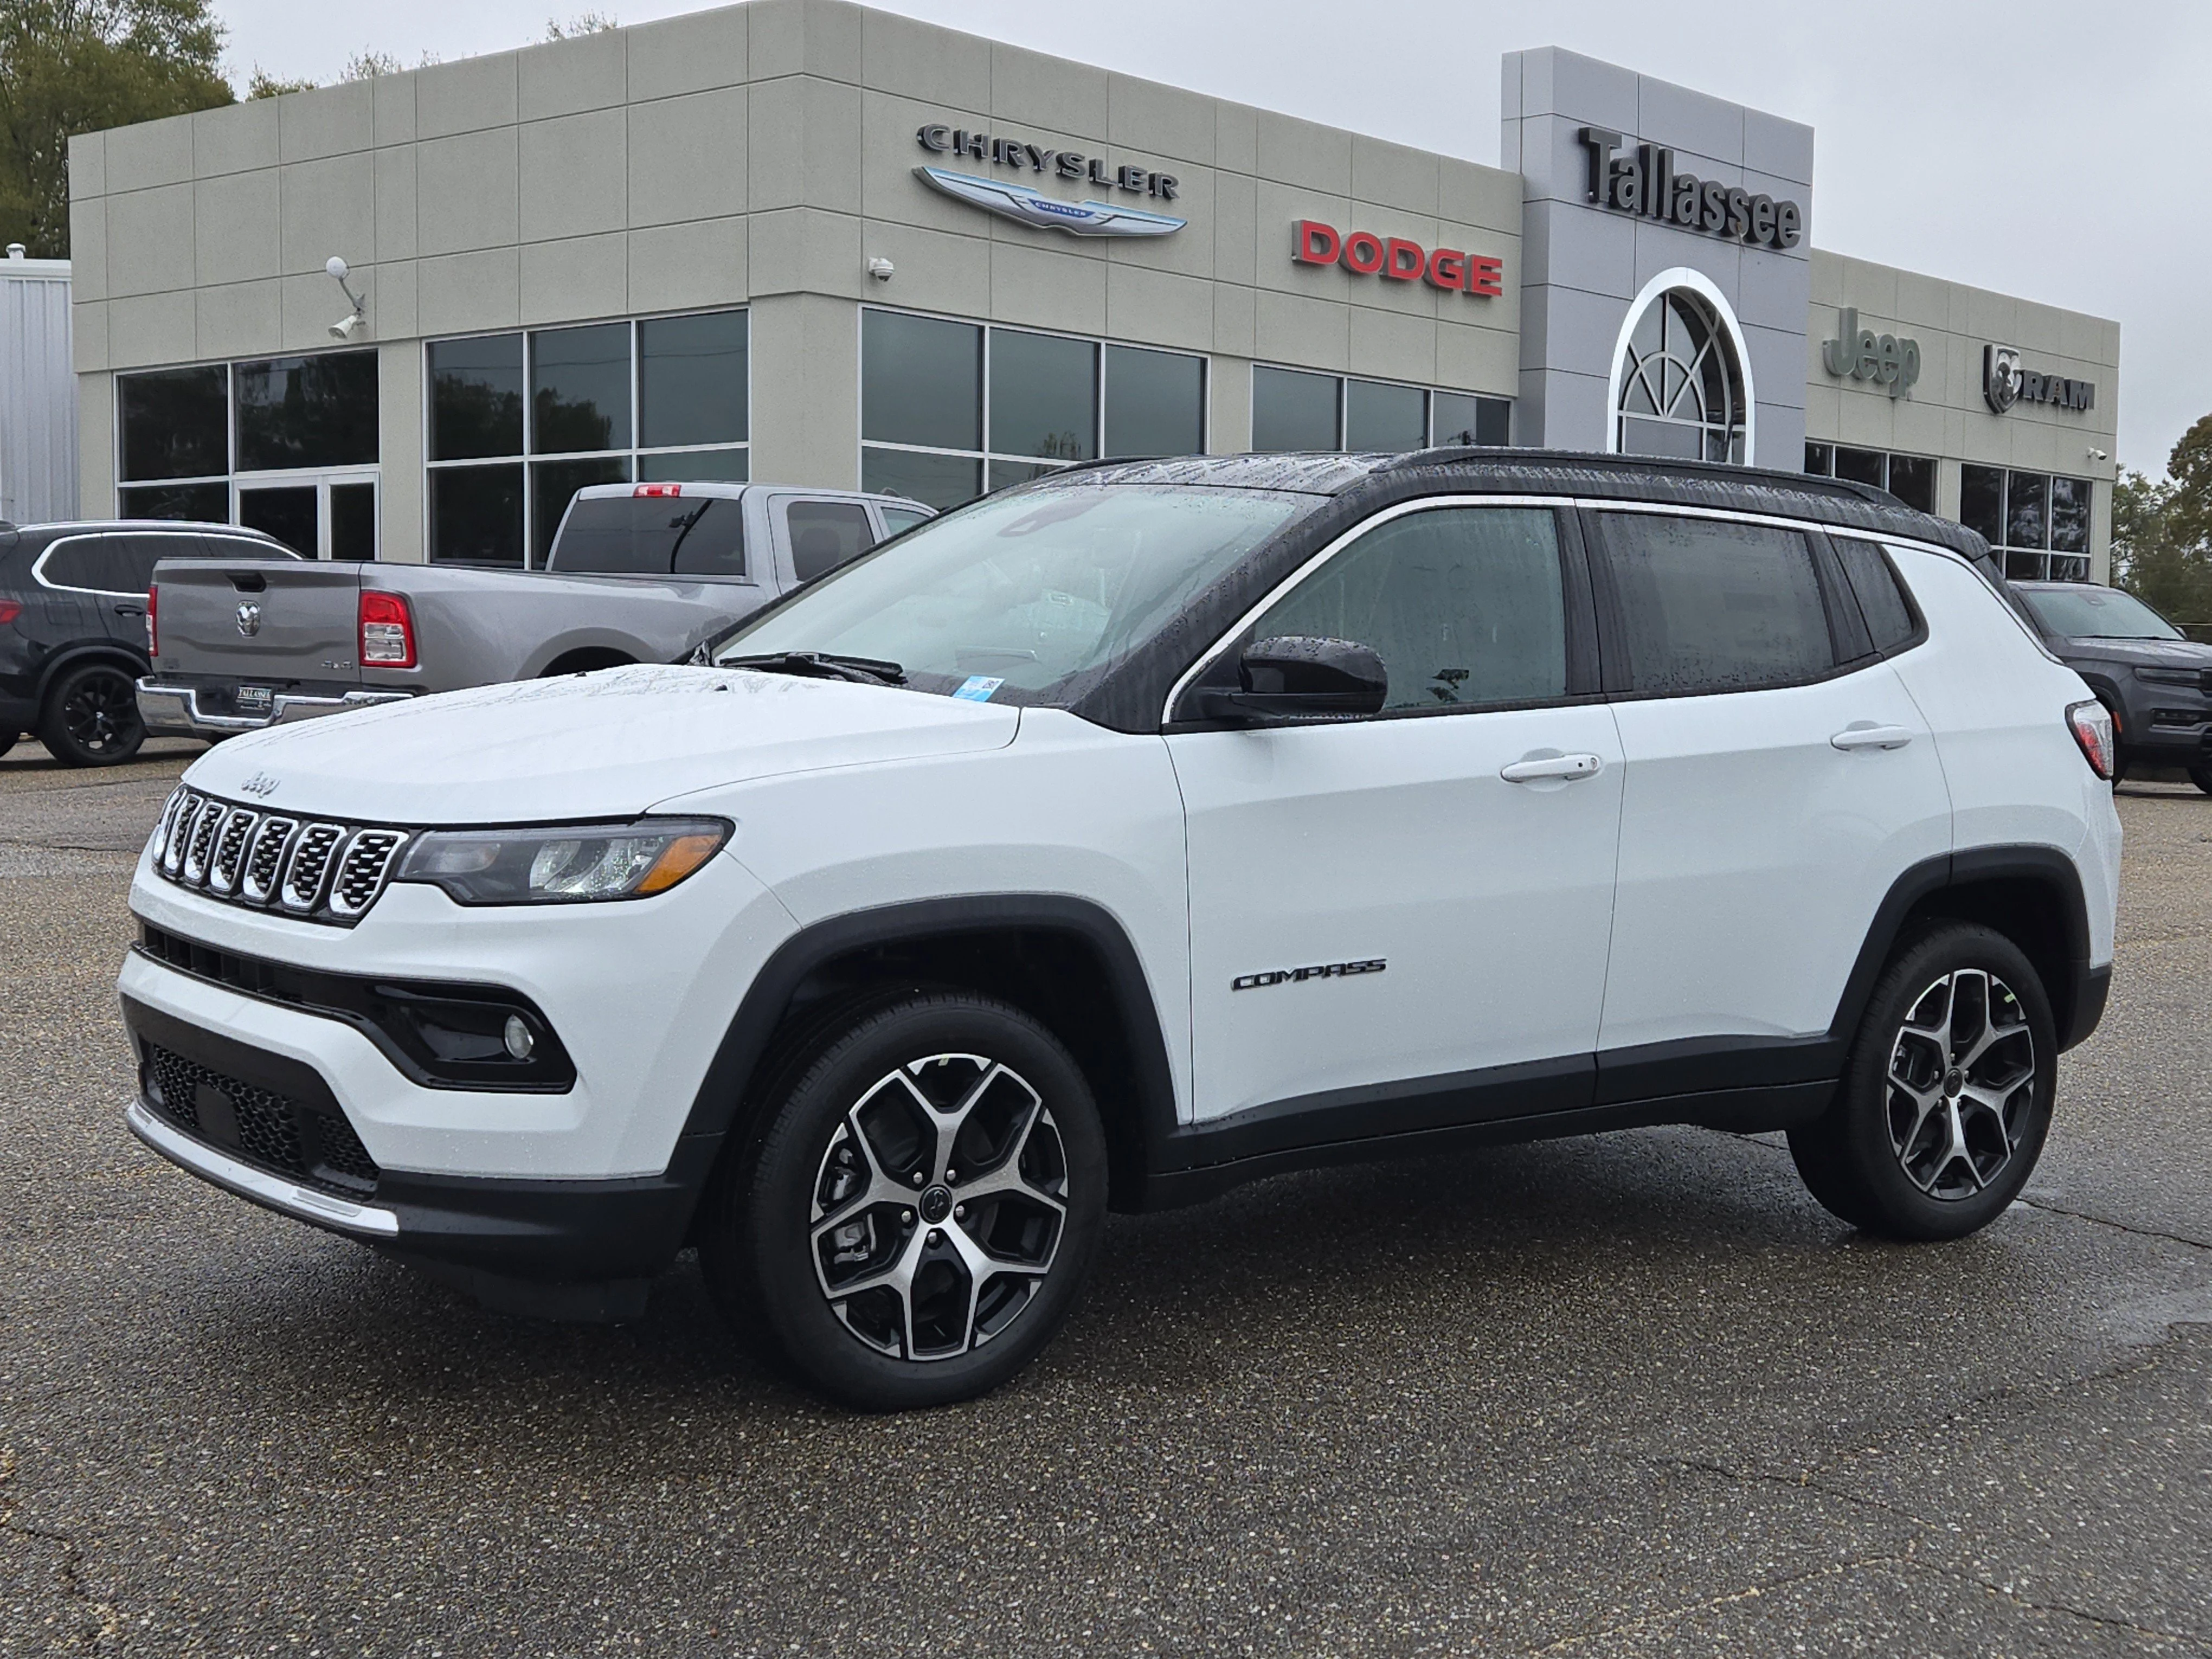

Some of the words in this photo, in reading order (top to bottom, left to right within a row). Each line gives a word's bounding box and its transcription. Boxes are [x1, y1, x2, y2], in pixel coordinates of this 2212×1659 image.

[916, 124, 1179, 199] CHRYSLER
[1579, 127, 1801, 248] Tallassee
[1035, 202, 1086, 216] CHRYSLER
[1292, 220, 1502, 296] DODGE
[1823, 307, 1920, 398] Jeep
[2021, 369, 2095, 410] RAM
[241, 770, 281, 799] Jeep
[1230, 958, 1387, 992] COMPASS
